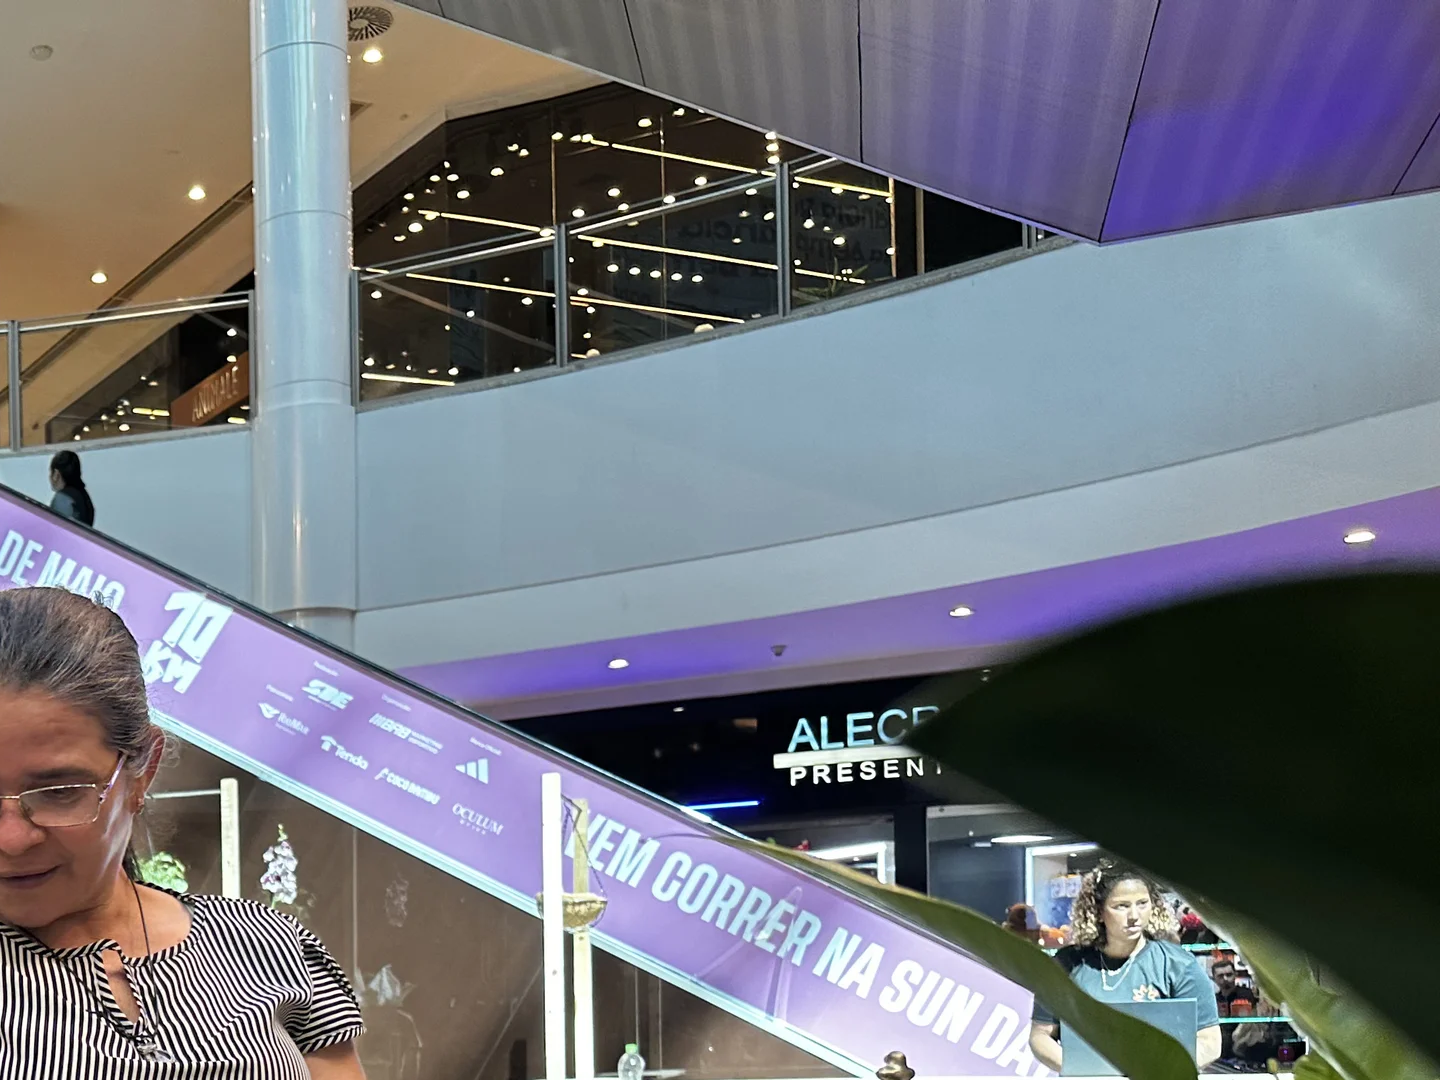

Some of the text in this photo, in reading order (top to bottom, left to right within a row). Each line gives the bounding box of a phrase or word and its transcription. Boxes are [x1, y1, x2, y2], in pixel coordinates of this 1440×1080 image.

[162, 591, 234, 664] 10
[141, 639, 202, 694] KM
[651, 851, 822, 966] CORRER
[812, 926, 886, 999] NA
[878, 959, 985, 1044] SUN
